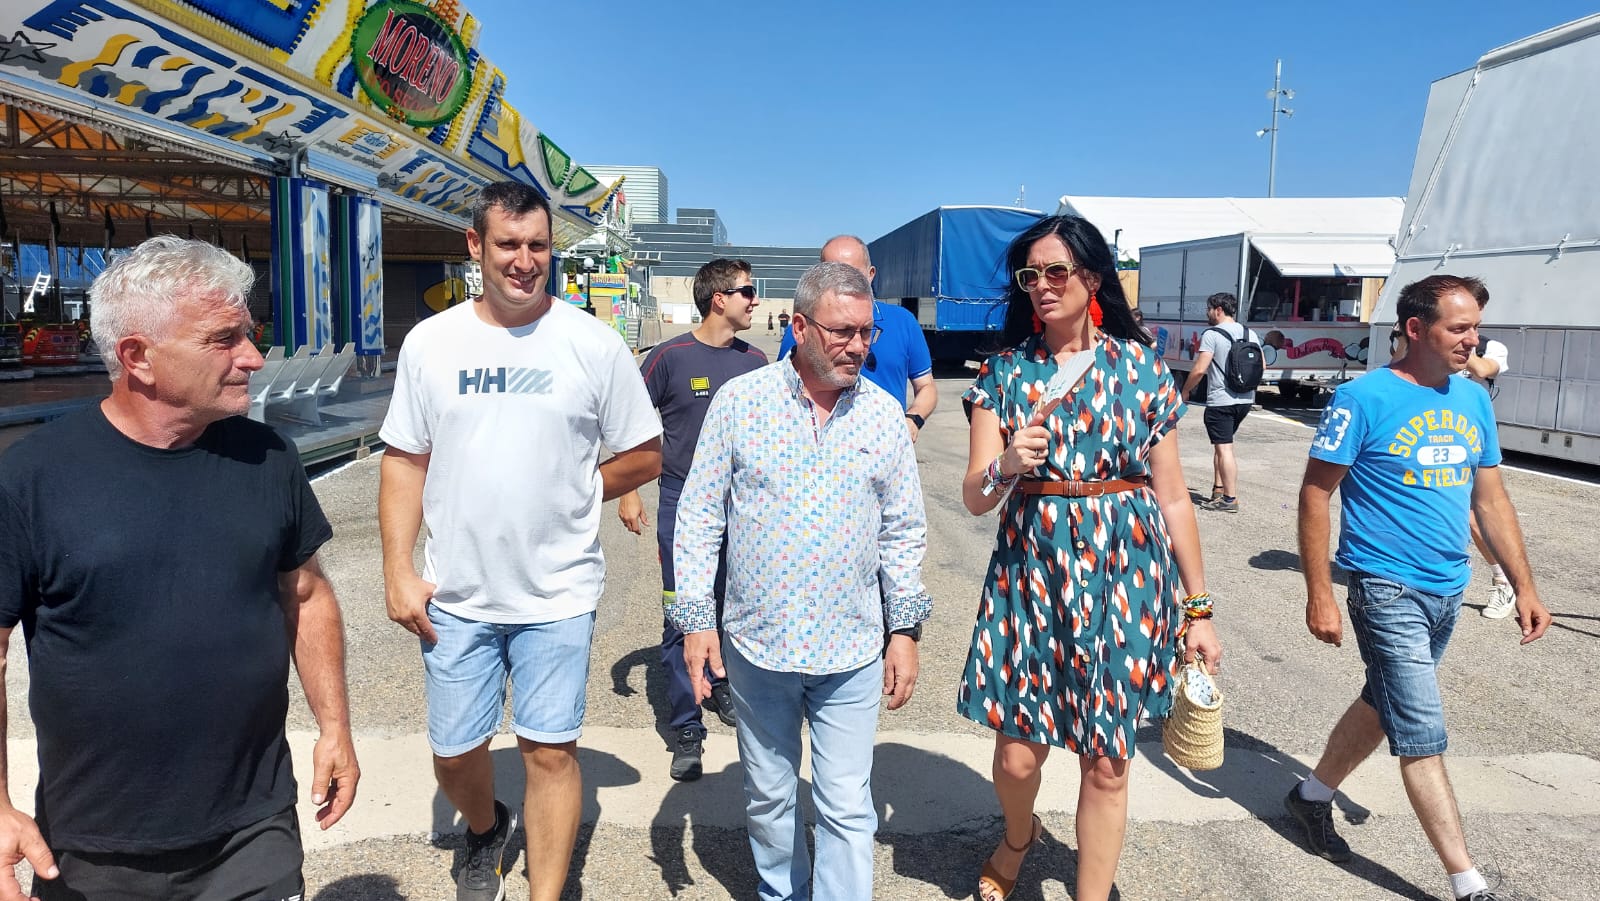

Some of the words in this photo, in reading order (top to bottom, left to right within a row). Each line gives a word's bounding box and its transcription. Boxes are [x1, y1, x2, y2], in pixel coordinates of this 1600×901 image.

[367, 8, 460, 104] MORENO
[1389, 409, 1482, 457] SUPERDRY
[1427, 435, 1454, 443] TRACK
[1432, 447, 1450, 463] 23
[1403, 470, 1417, 485] &
[1423, 467, 1471, 488] FIELD
